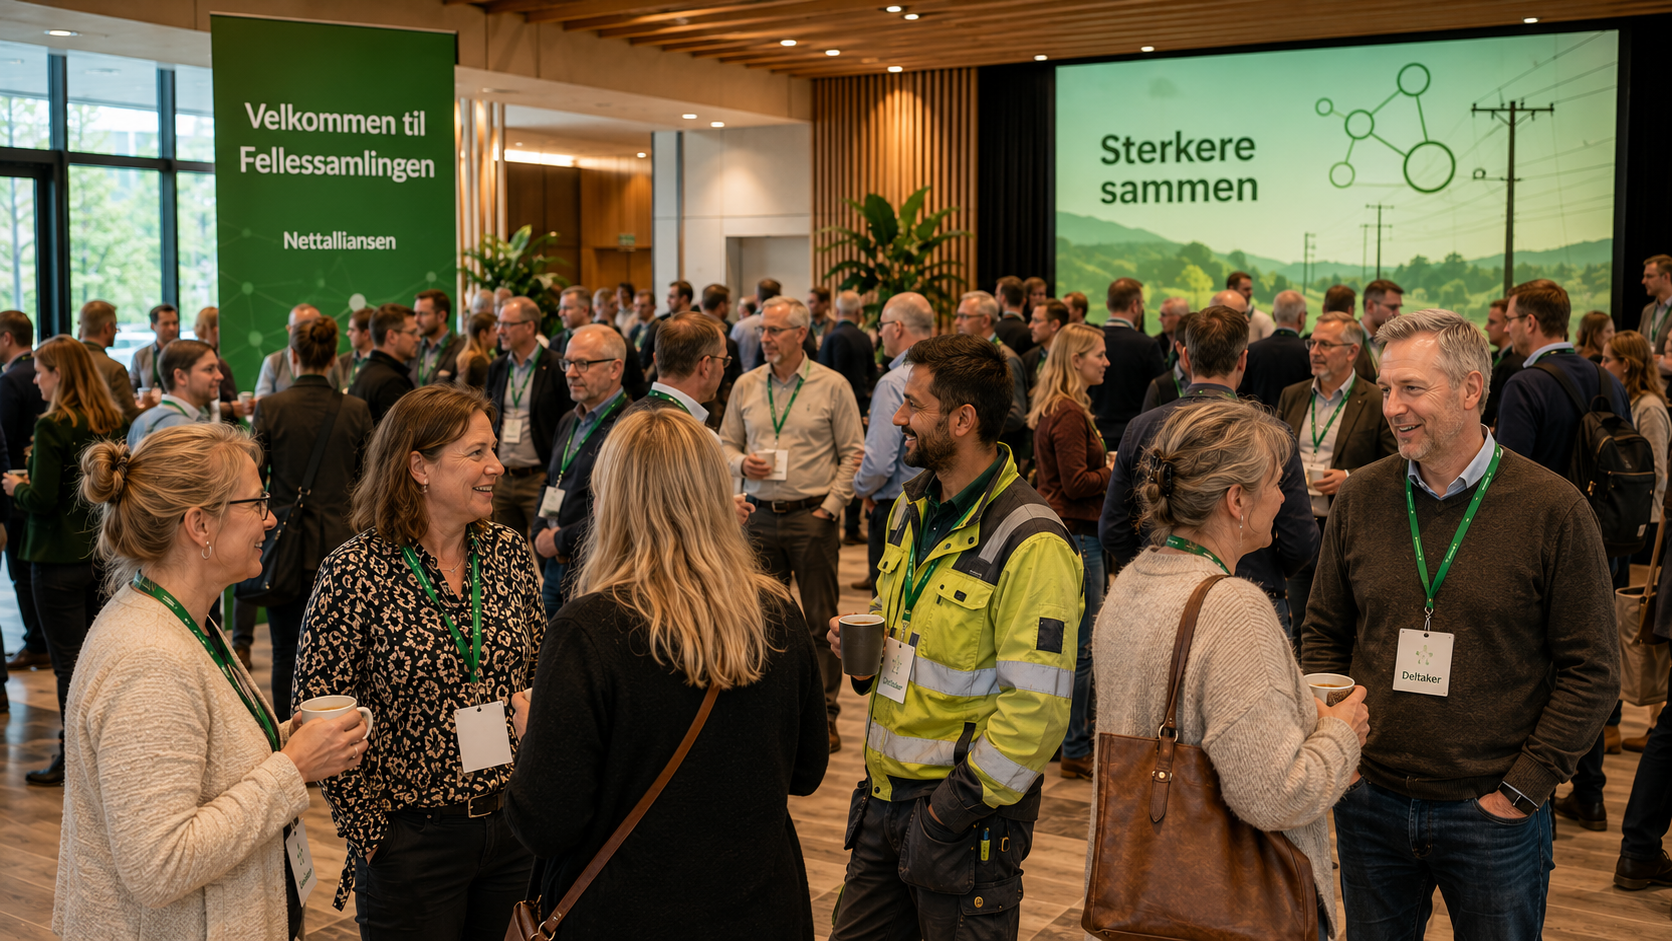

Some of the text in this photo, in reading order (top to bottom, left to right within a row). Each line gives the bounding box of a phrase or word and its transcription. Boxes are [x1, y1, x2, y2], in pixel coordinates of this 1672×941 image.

[244, 102, 426, 136] Velkommen til
[1100, 130, 1256, 165] Sterkere
[239, 145, 435, 183] Fellessamlingen
[1100, 177, 1258, 204] sammen
[283, 230, 397, 250] Nettalliansen
[1402, 671, 1442, 684] Deltaker
